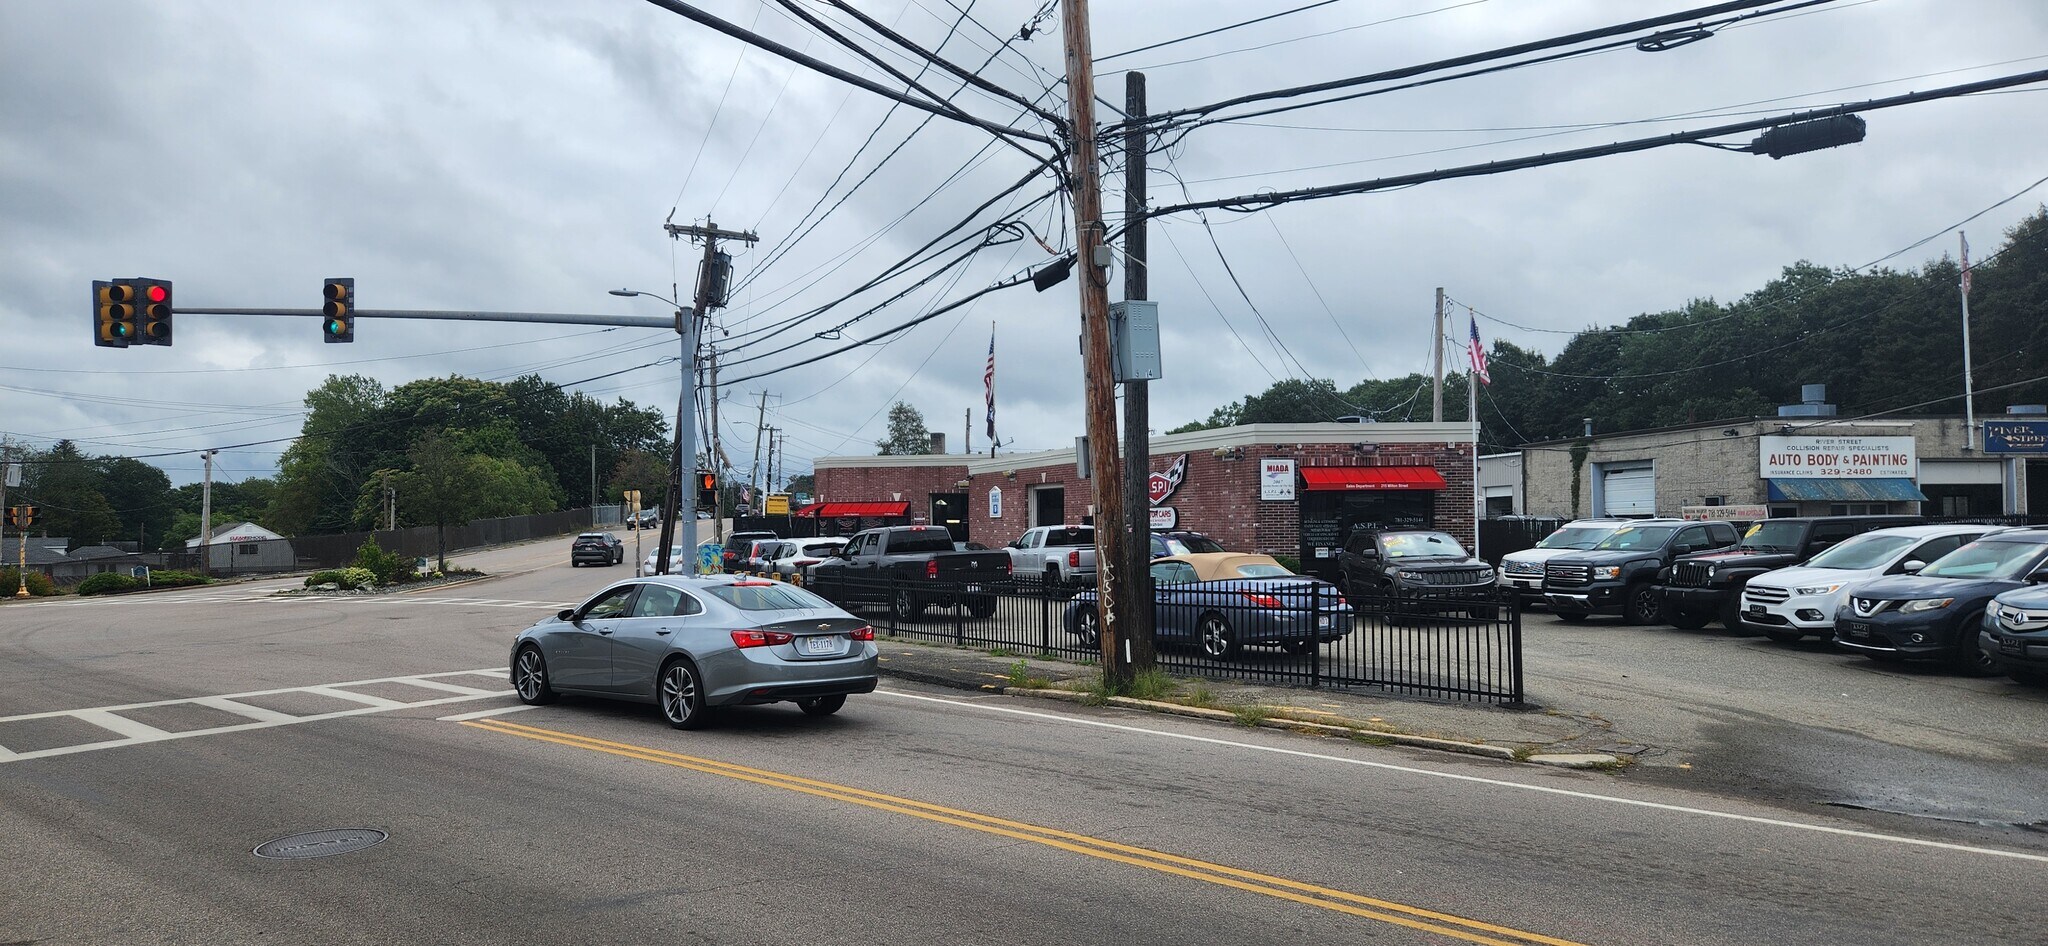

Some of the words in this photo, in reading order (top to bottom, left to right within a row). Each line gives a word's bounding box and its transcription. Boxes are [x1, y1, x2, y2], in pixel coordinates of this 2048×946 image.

[1769, 454, 1801, 466] AUTO
[1807, 454, 1839, 466] BODY
[1842, 455, 1850, 465] &
[1853, 454, 1908, 466] PAINTING
[1266, 464, 1289, 473] MIADA
[1716, 509, 1724, 518] 329
